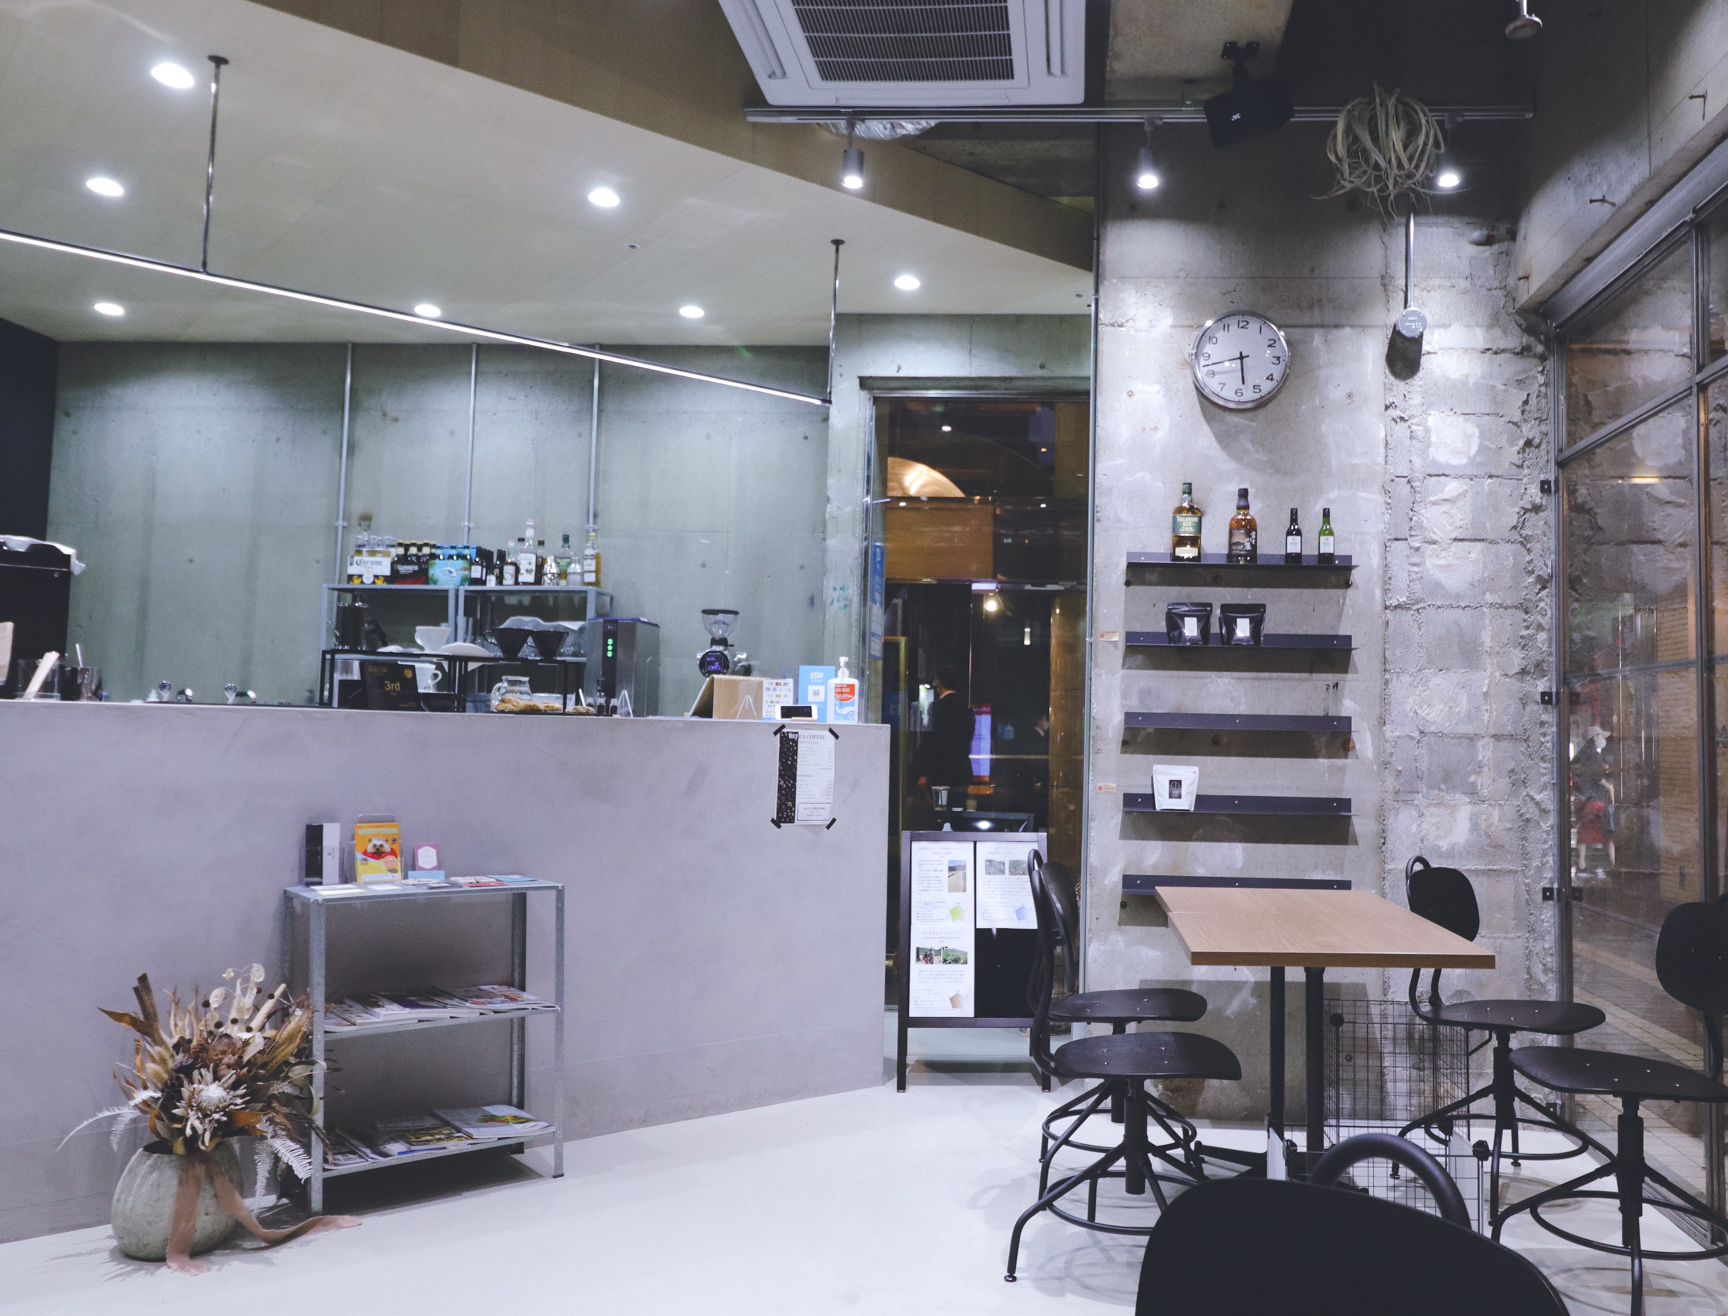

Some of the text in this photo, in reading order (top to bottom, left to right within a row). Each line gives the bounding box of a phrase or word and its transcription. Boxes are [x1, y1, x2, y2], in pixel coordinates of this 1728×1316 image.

[1223, 324, 1230, 333] 11
[1237, 320, 1250, 329] 12
[1208, 336, 1218, 345] 10
[1267, 338, 1277, 348] 2
[1202, 352, 1211, 361] 9
[1271, 356, 1281, 366] 3
[1206, 369, 1216, 379] 8
[1265, 373, 1275, 383] 4
[1218, 382, 1227, 392] 7
[1252, 385, 1262, 394] 5
[1234, 388, 1244, 397] 6
[355, 558, 383, 567] Corona
[384, 680, 401, 691] 3rd
